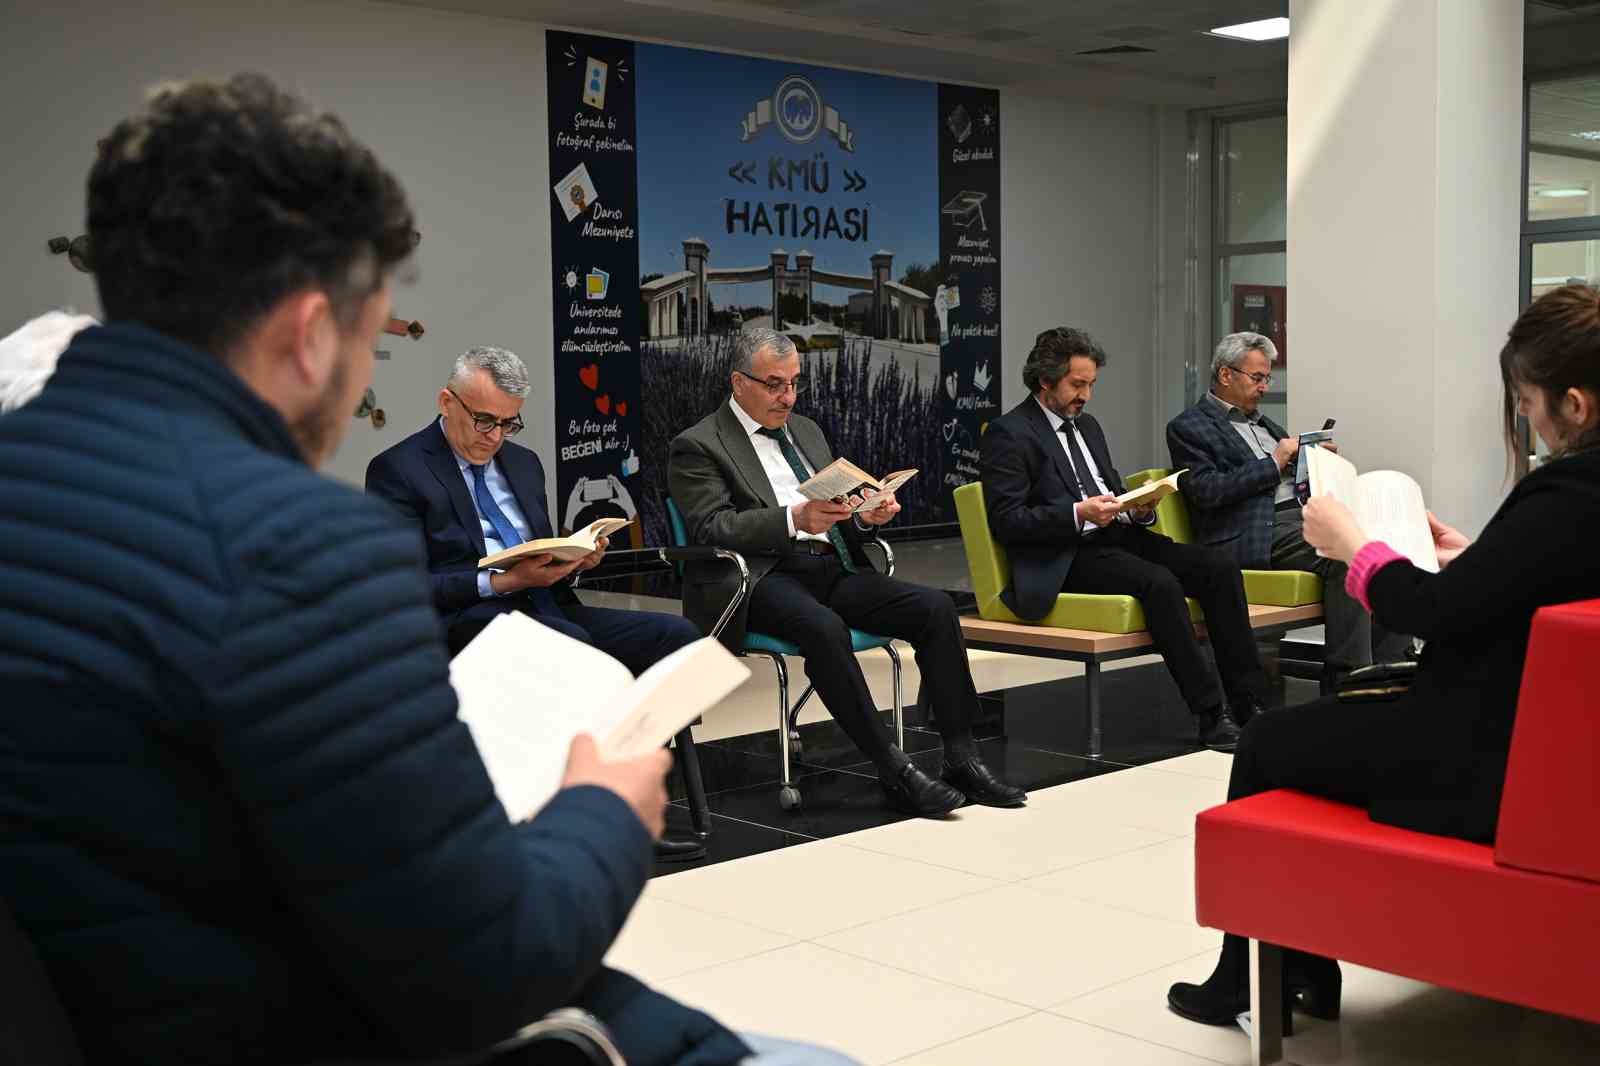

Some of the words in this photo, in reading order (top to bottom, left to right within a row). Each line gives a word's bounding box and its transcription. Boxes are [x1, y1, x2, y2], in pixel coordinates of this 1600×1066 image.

[608, 116, 617, 129] bi
[768, 152, 829, 193] KMÜ
[592, 201, 622, 219] Darısı
[581, 221, 634, 242] Mezuniyete
[568, 419, 580, 436] Bu
[582, 419, 600, 435] foto
[602, 419, 617, 436] çok
